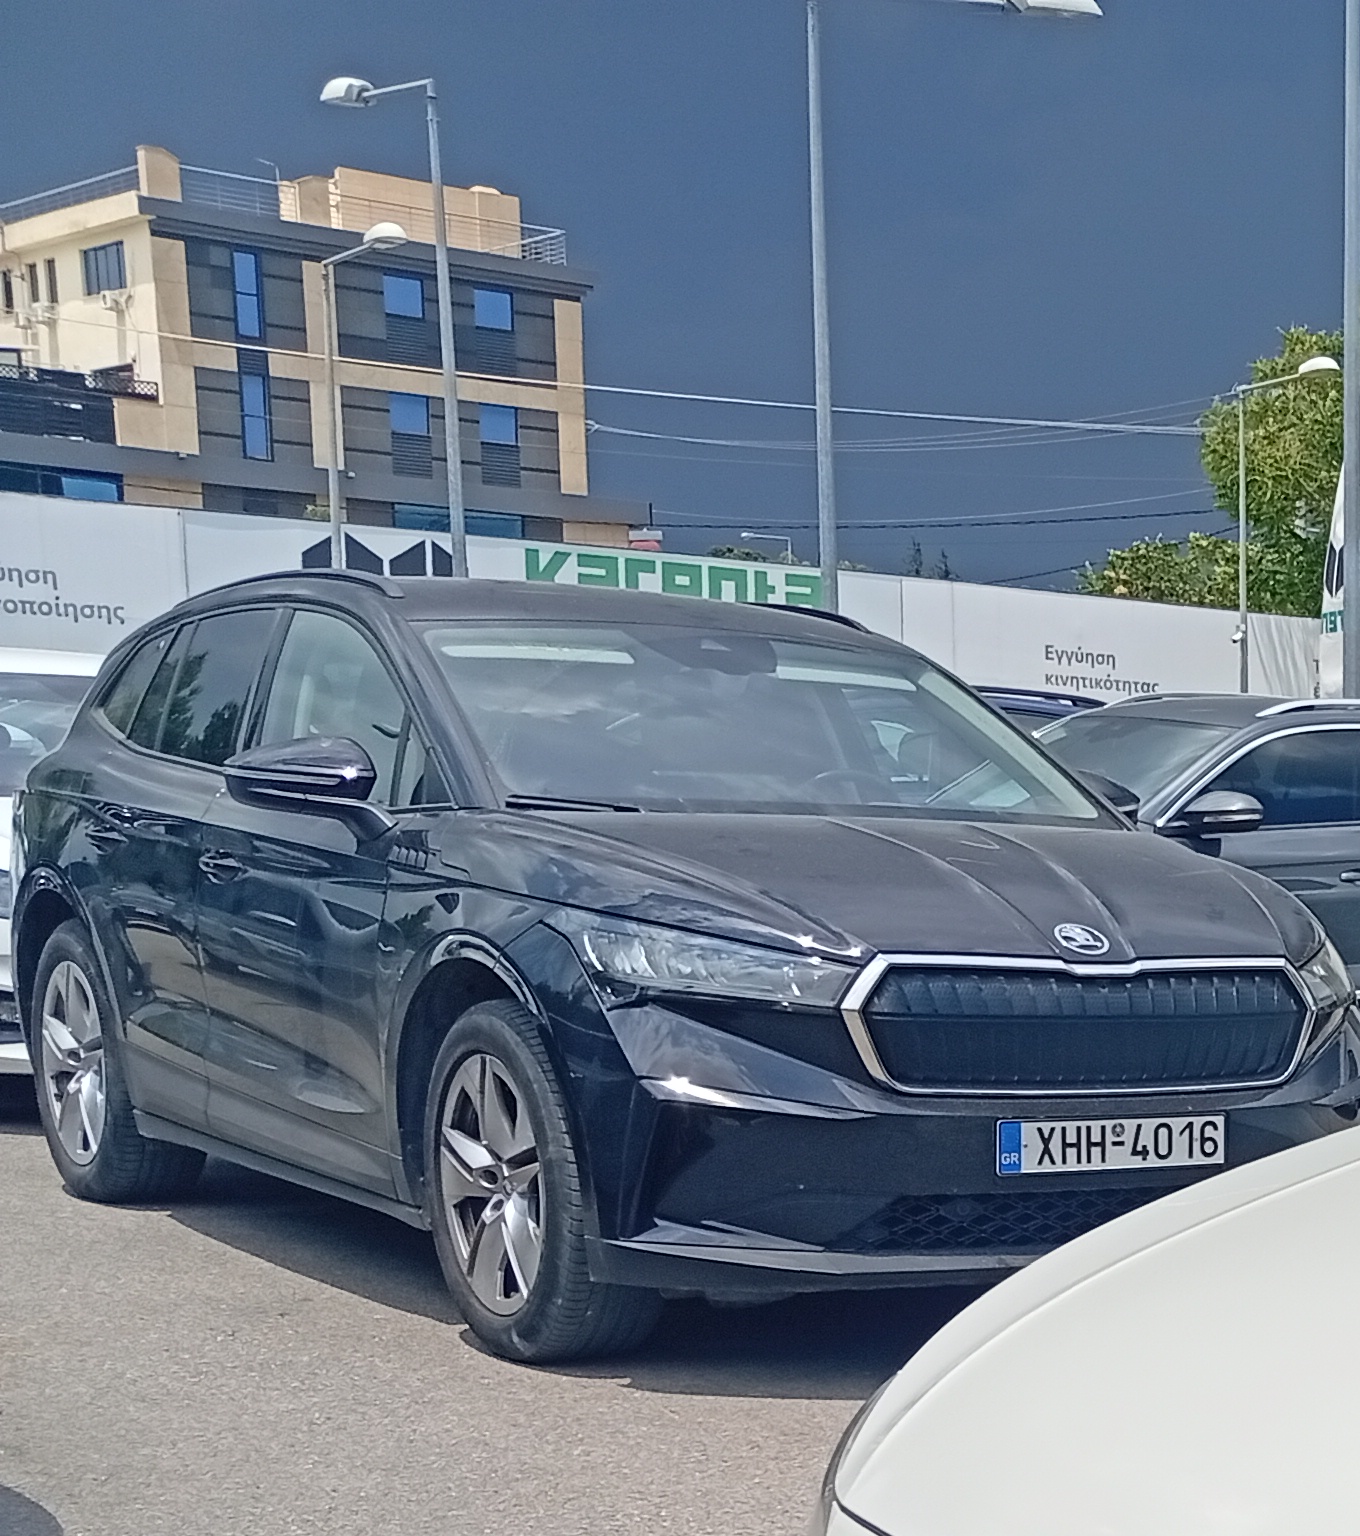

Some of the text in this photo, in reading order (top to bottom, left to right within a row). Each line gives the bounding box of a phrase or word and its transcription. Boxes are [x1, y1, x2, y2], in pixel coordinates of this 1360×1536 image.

[0, 596, 125, 625] οποίησης
[1044, 644, 1116, 671] Εγγύηση
[1044, 673, 1160, 696] κινητικότητας
[1001, 1152, 1020, 1165] GR
